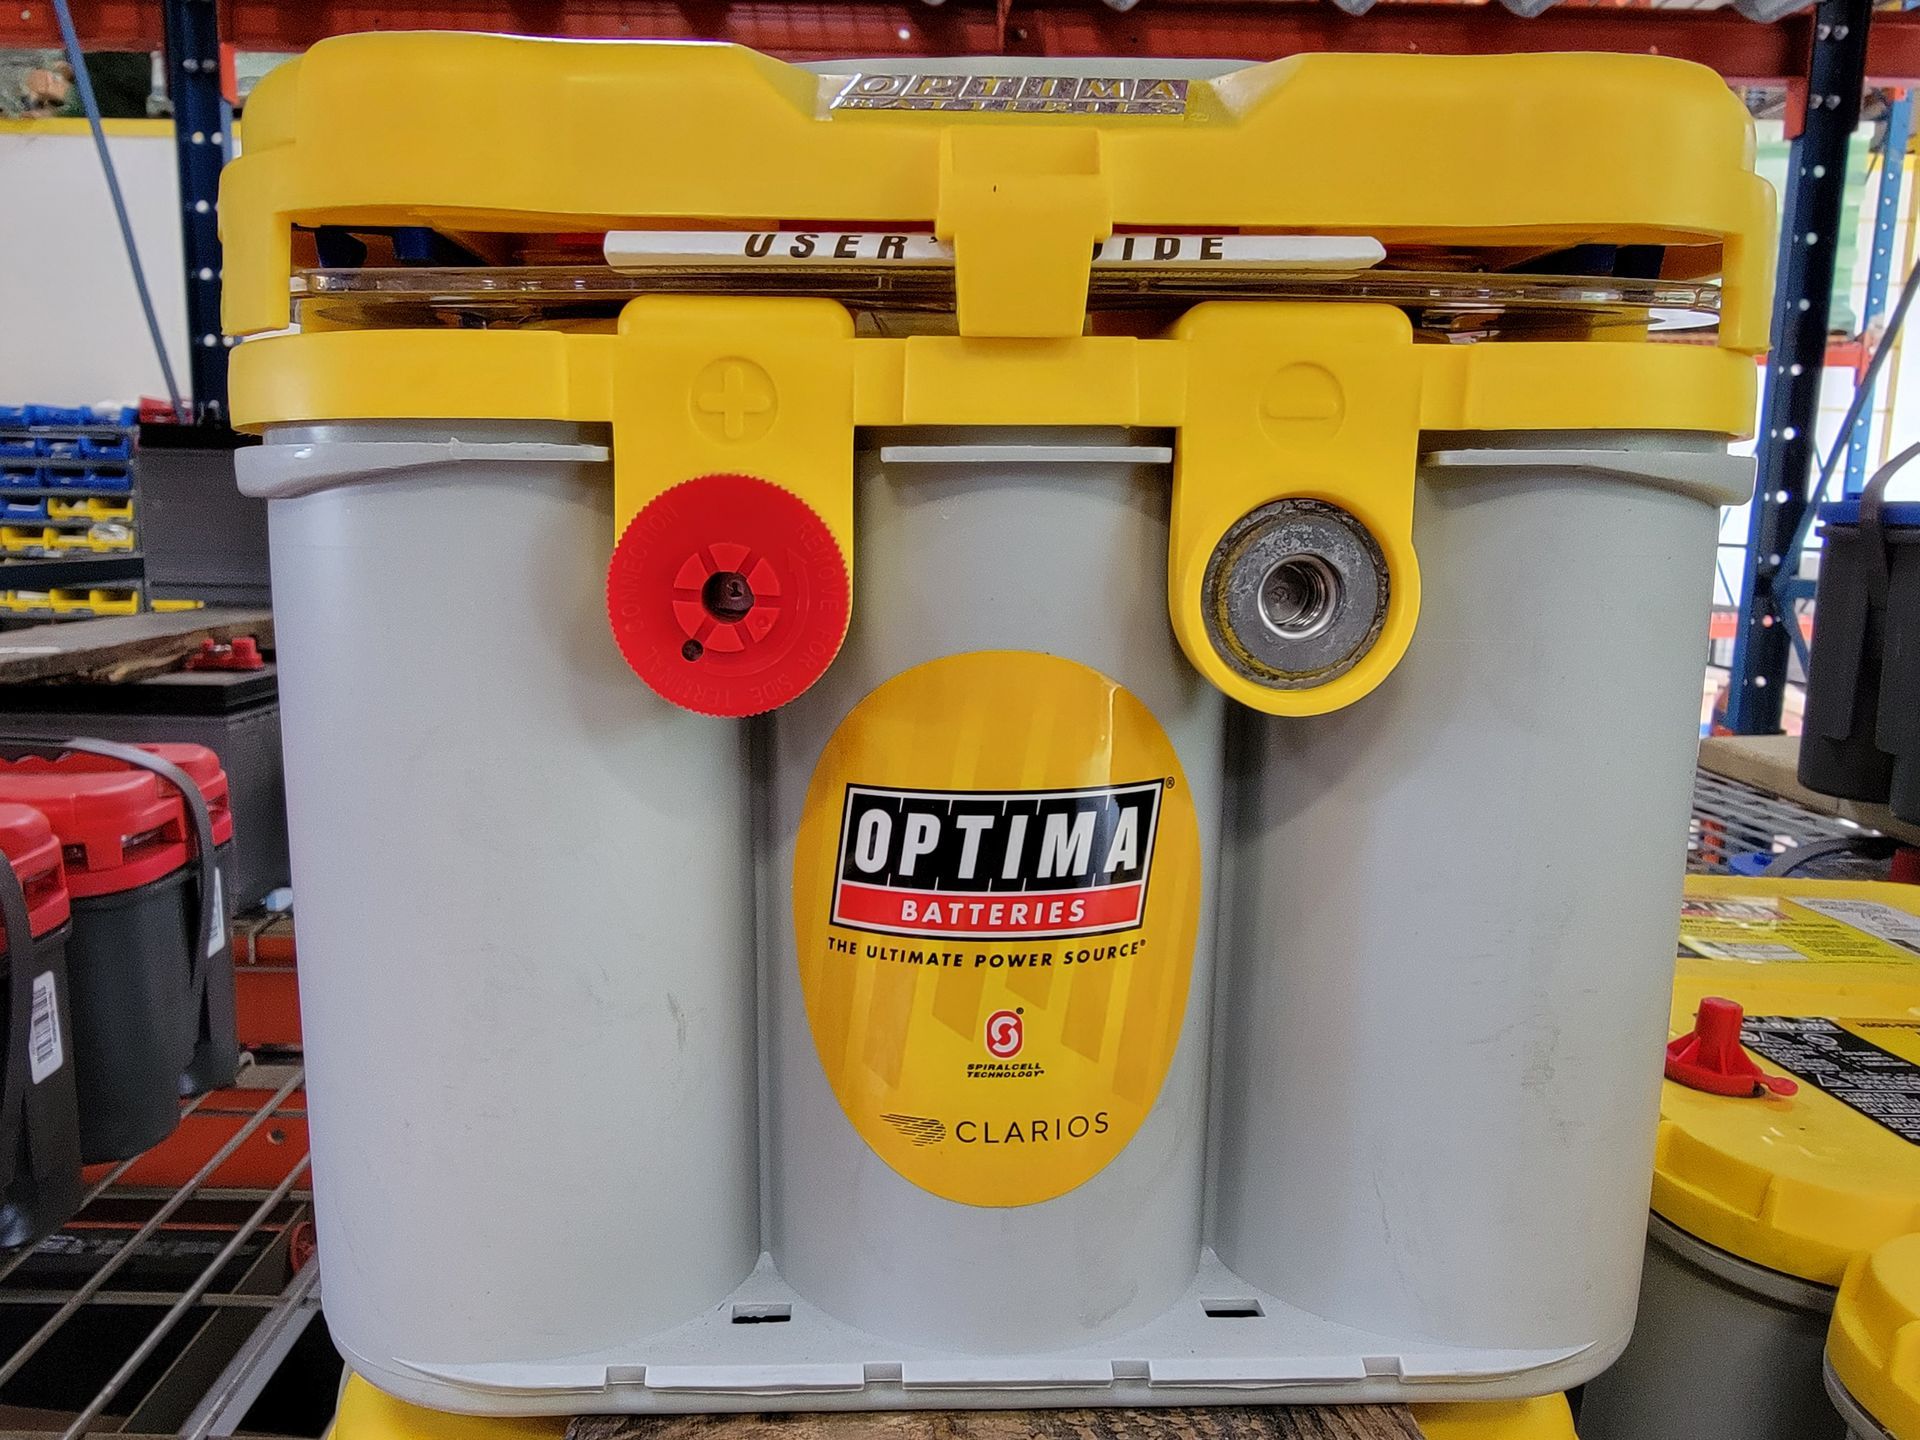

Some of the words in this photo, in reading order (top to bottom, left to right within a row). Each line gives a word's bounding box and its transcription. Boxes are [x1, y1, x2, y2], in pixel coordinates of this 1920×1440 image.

[856, 75, 1179, 99] OPTIMA
[854, 807, 1138, 880] OPTIMA
[901, 899, 1086, 926] BATTERIES
[828, 937, 858, 955] THE
[867, 946, 963, 968] ULTIMATE
[974, 953, 1052, 968] POWER
[956, 1112, 1109, 1144] CLARIOS
